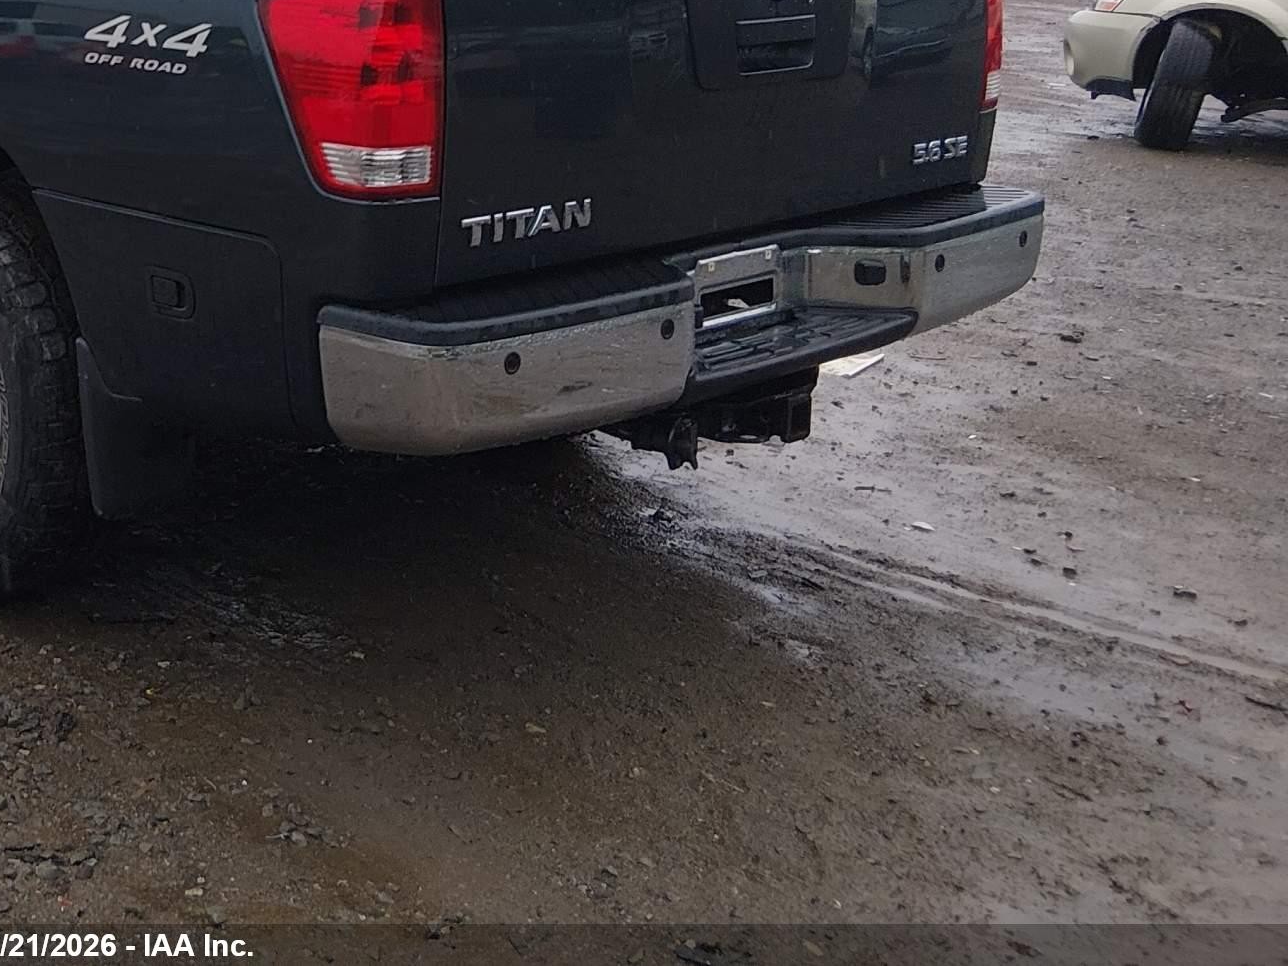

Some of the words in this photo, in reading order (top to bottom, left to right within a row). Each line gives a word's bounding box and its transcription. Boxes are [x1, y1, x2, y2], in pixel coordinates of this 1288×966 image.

[85, 52, 124, 66] OFF
[130, 58, 187, 74] ROAD
[944, 135, 968, 159] SE
[462, 198, 592, 247] TITAN
